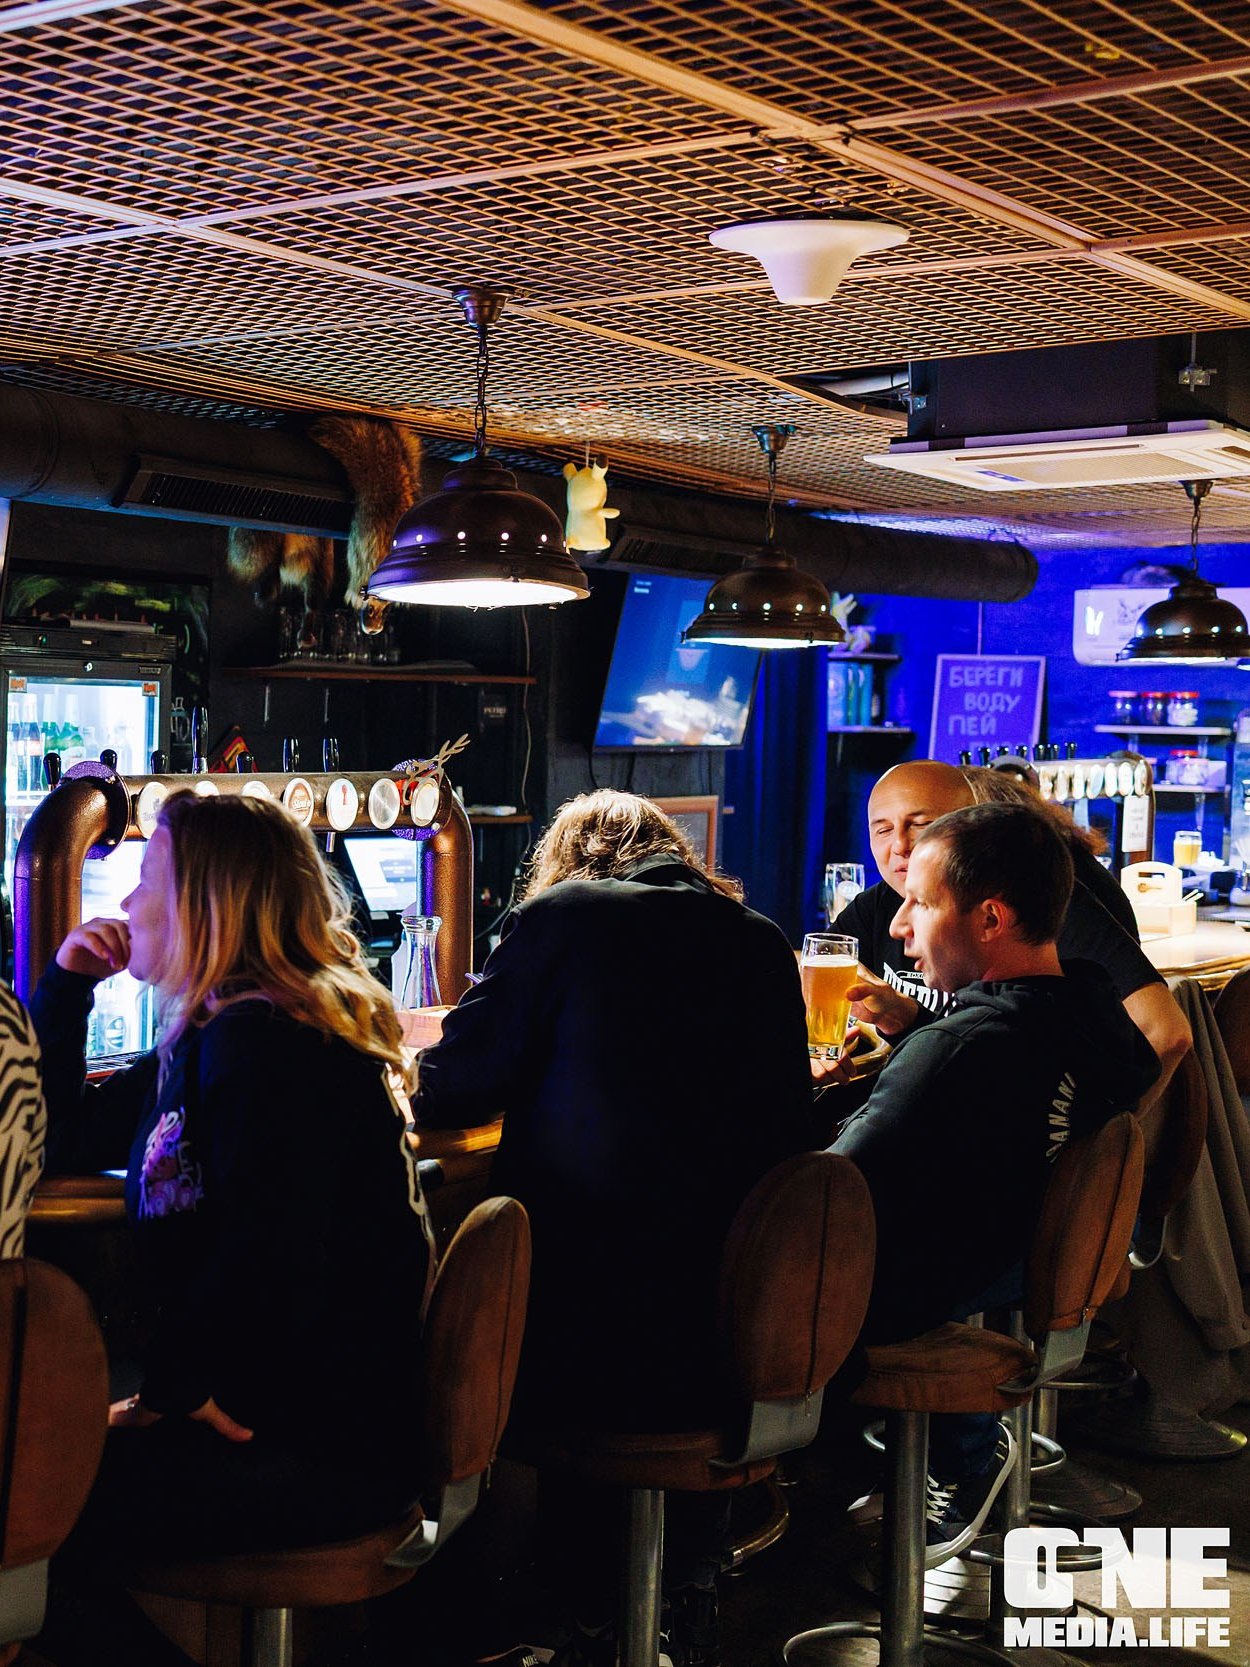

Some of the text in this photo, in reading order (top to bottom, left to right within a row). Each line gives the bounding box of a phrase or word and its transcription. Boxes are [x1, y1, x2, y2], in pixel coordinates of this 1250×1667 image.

[948, 665, 1024, 688] БЕРЕГИ
[963, 691, 1021, 714] ВОДУ
[947, 712, 998, 737] ПЕЙ
